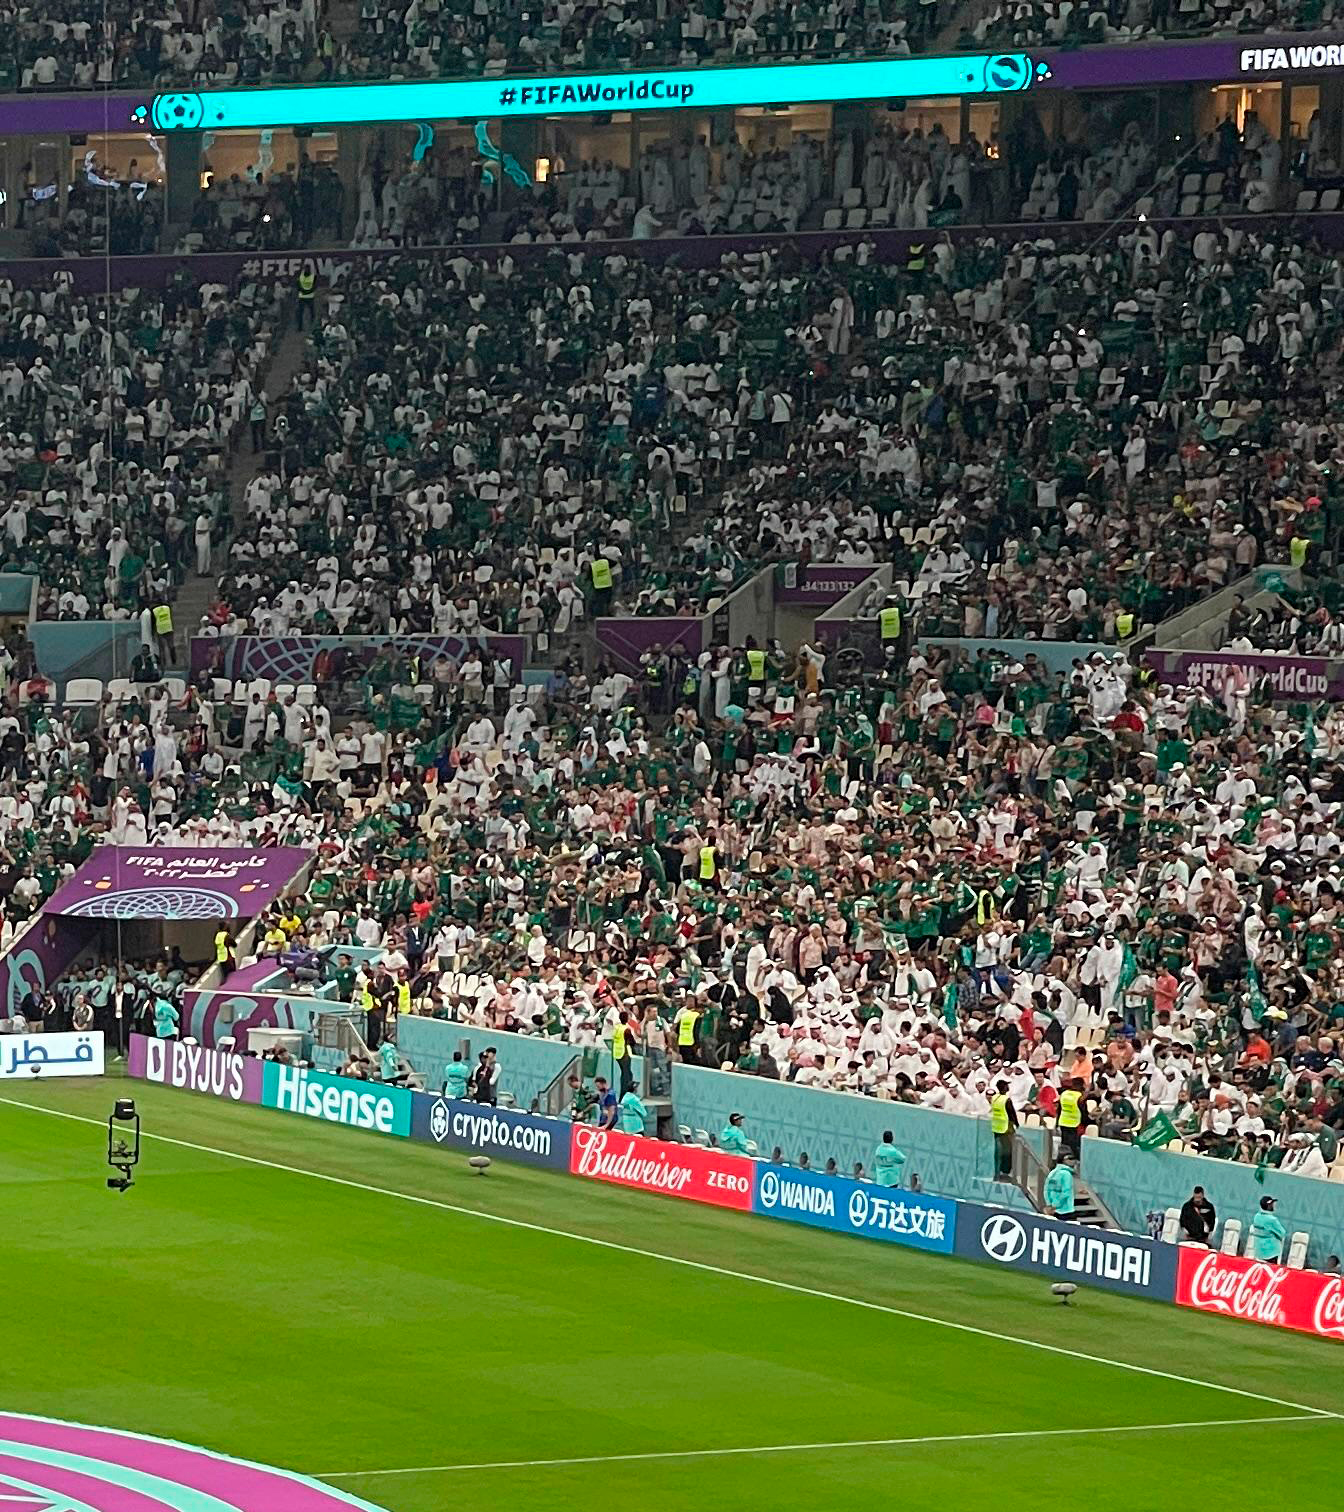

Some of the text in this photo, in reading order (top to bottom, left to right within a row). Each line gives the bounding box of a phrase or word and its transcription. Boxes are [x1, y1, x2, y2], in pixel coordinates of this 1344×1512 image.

[1241, 45, 1344, 70] FIFA WOR
[499, 80, 694, 105] #FIFAWorldCup
[125, 856, 164, 866] FIFA
[5, 1037, 93, 1073] قطر
[171, 1040, 244, 1100] BYJU'S
[277, 1065, 394, 1132] Hisense
[453, 1113, 551, 1156] crypto.com
[576, 1127, 749, 1194] Budweiser ZERO
[780, 1180, 835, 1218] WANDA
[868, 1197, 945, 1241] 万达文旅
[1031, 1227, 1151, 1286] HYUNDAI
[1191, 1253, 1289, 1322] Coca-Cola
